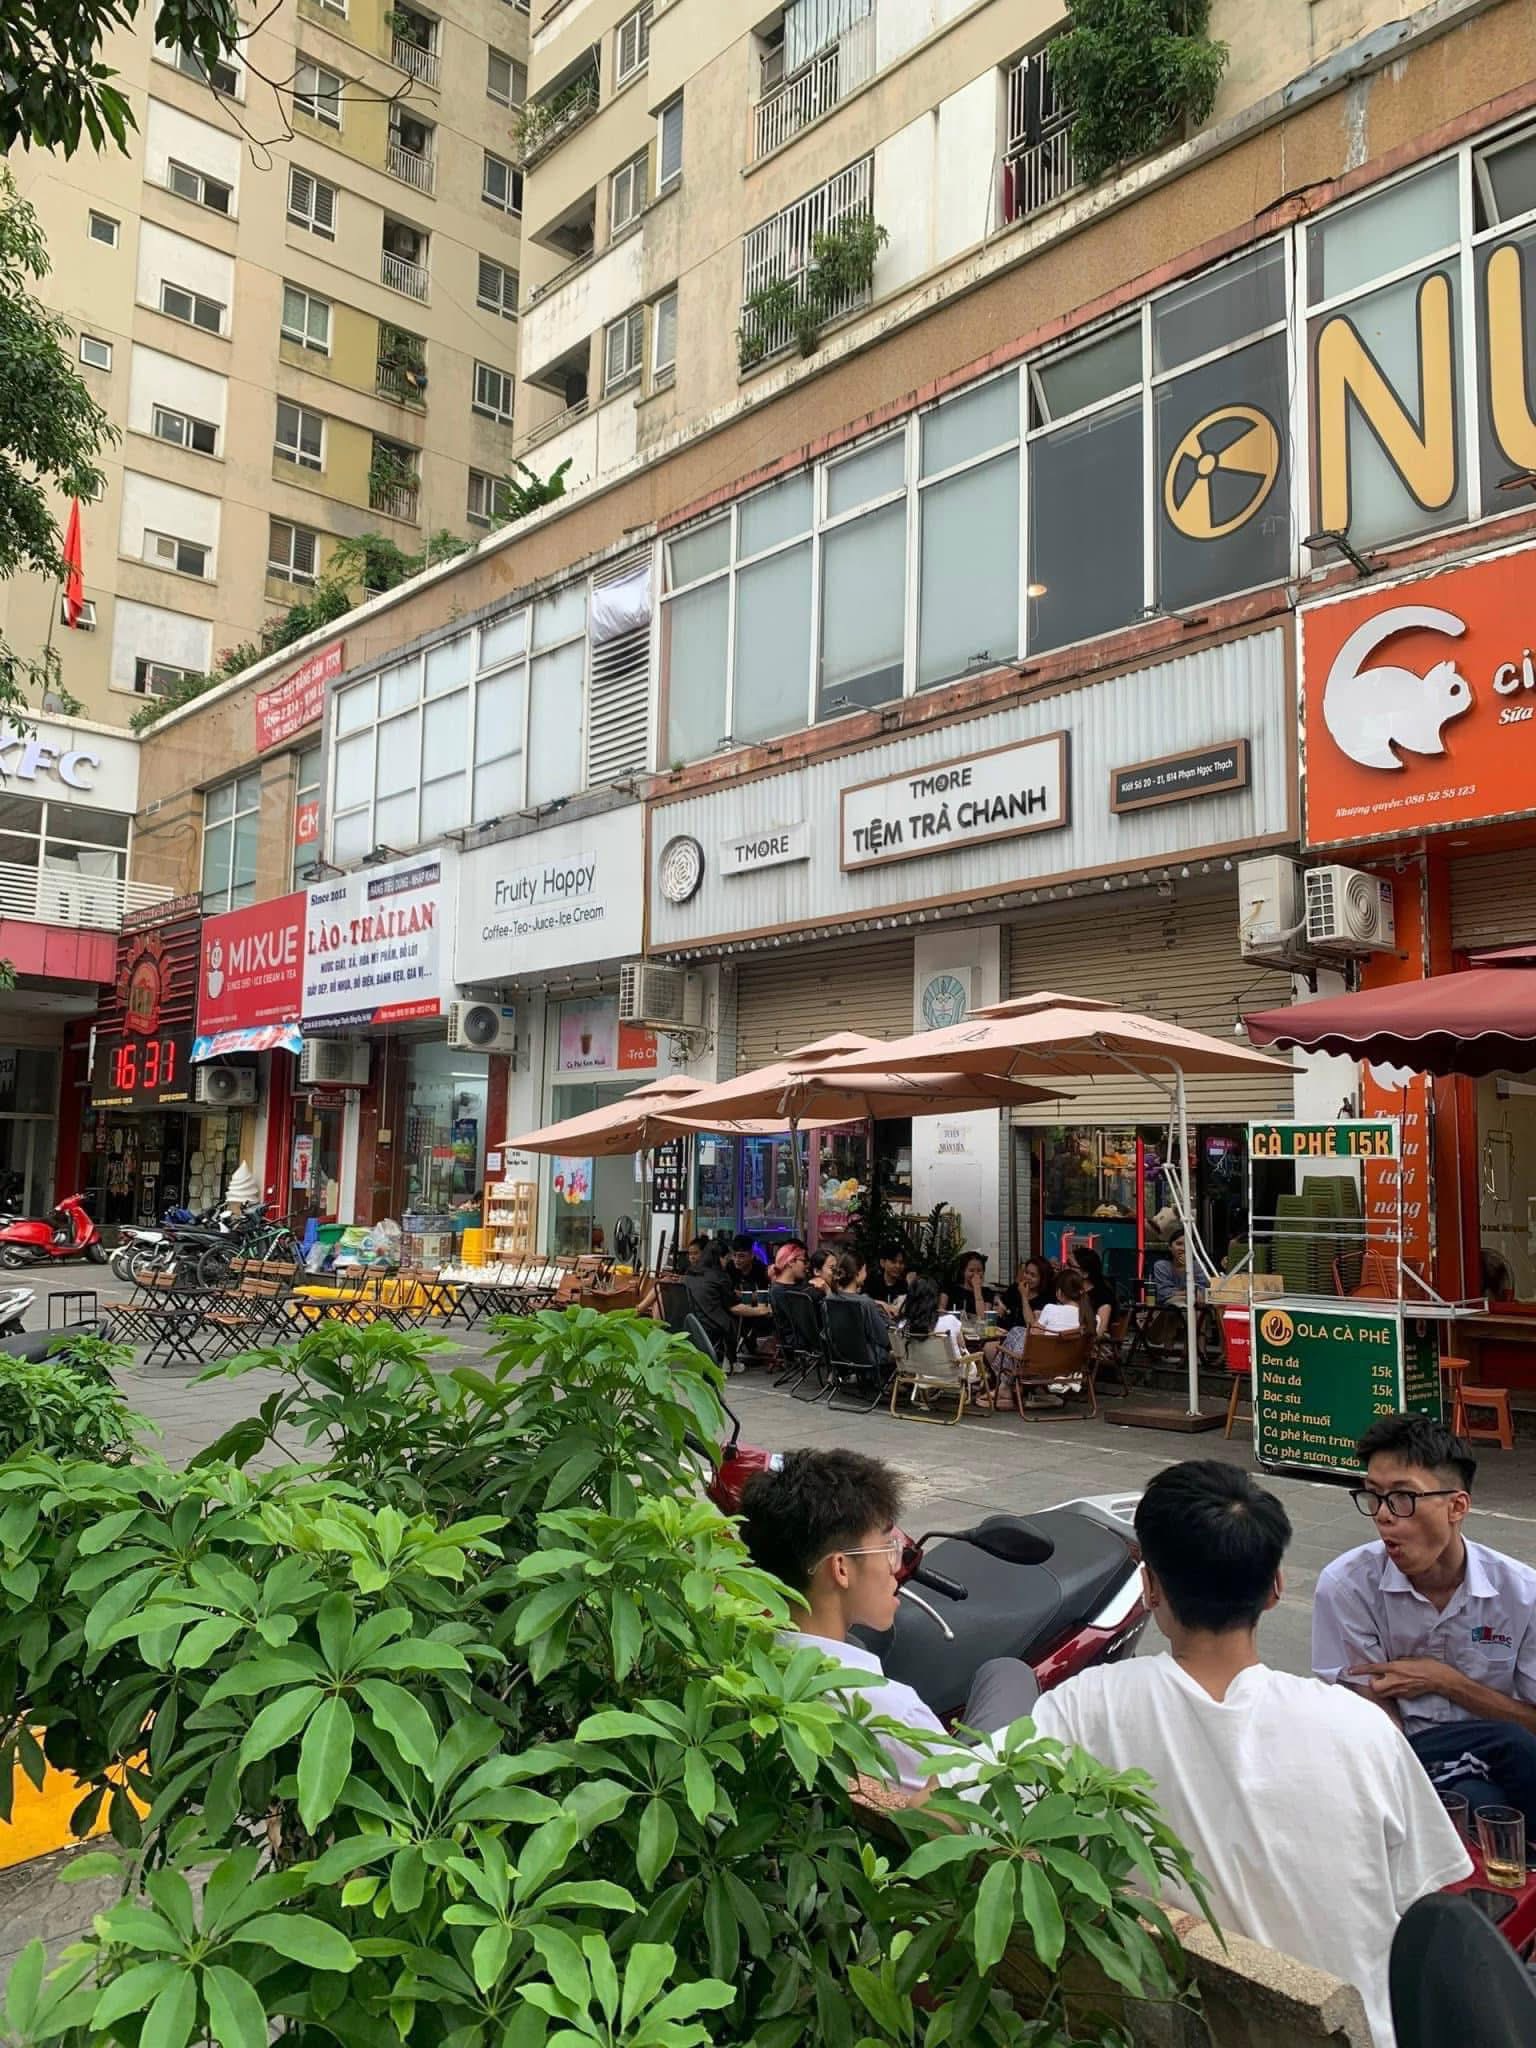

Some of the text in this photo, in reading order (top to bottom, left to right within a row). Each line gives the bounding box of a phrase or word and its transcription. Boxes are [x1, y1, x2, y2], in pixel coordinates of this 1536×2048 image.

[910, 767, 972, 800] TMORE
[853, 786, 1047, 855] TIỆM TRÀ CHANH
[735, 835, 790, 863] TMORE
[495, 864, 595, 905] Fruity Happy
[311, 891, 330, 906] Since
[573, 906, 604, 922] Cream
[228, 924, 299, 977] MIXUE
[1254, 1128, 1282, 1156] CÀ
[1293, 1127, 1337, 1157] PHÊ
[1348, 1131, 1389, 1156] 15K
[1297, 1323, 1391, 1345] OLA CÀ PHÊ
[1262, 1353, 1393, 1377] Đen đá 15k
[1263, 1371, 1393, 1397] Nâu đá 15k
[1263, 1389, 1283, 1404] Bạc
[1373, 1402, 1395, 1416] 20k
[1280, 1410, 1300, 1423] phê
[1302, 1414, 1331, 1427] muối
[1280, 1428, 1300, 1441] phê
[1302, 1430, 1326, 1444] kem
[1281, 1446, 1301, 1459] phê
[1303, 1450, 1338, 1466] sương
